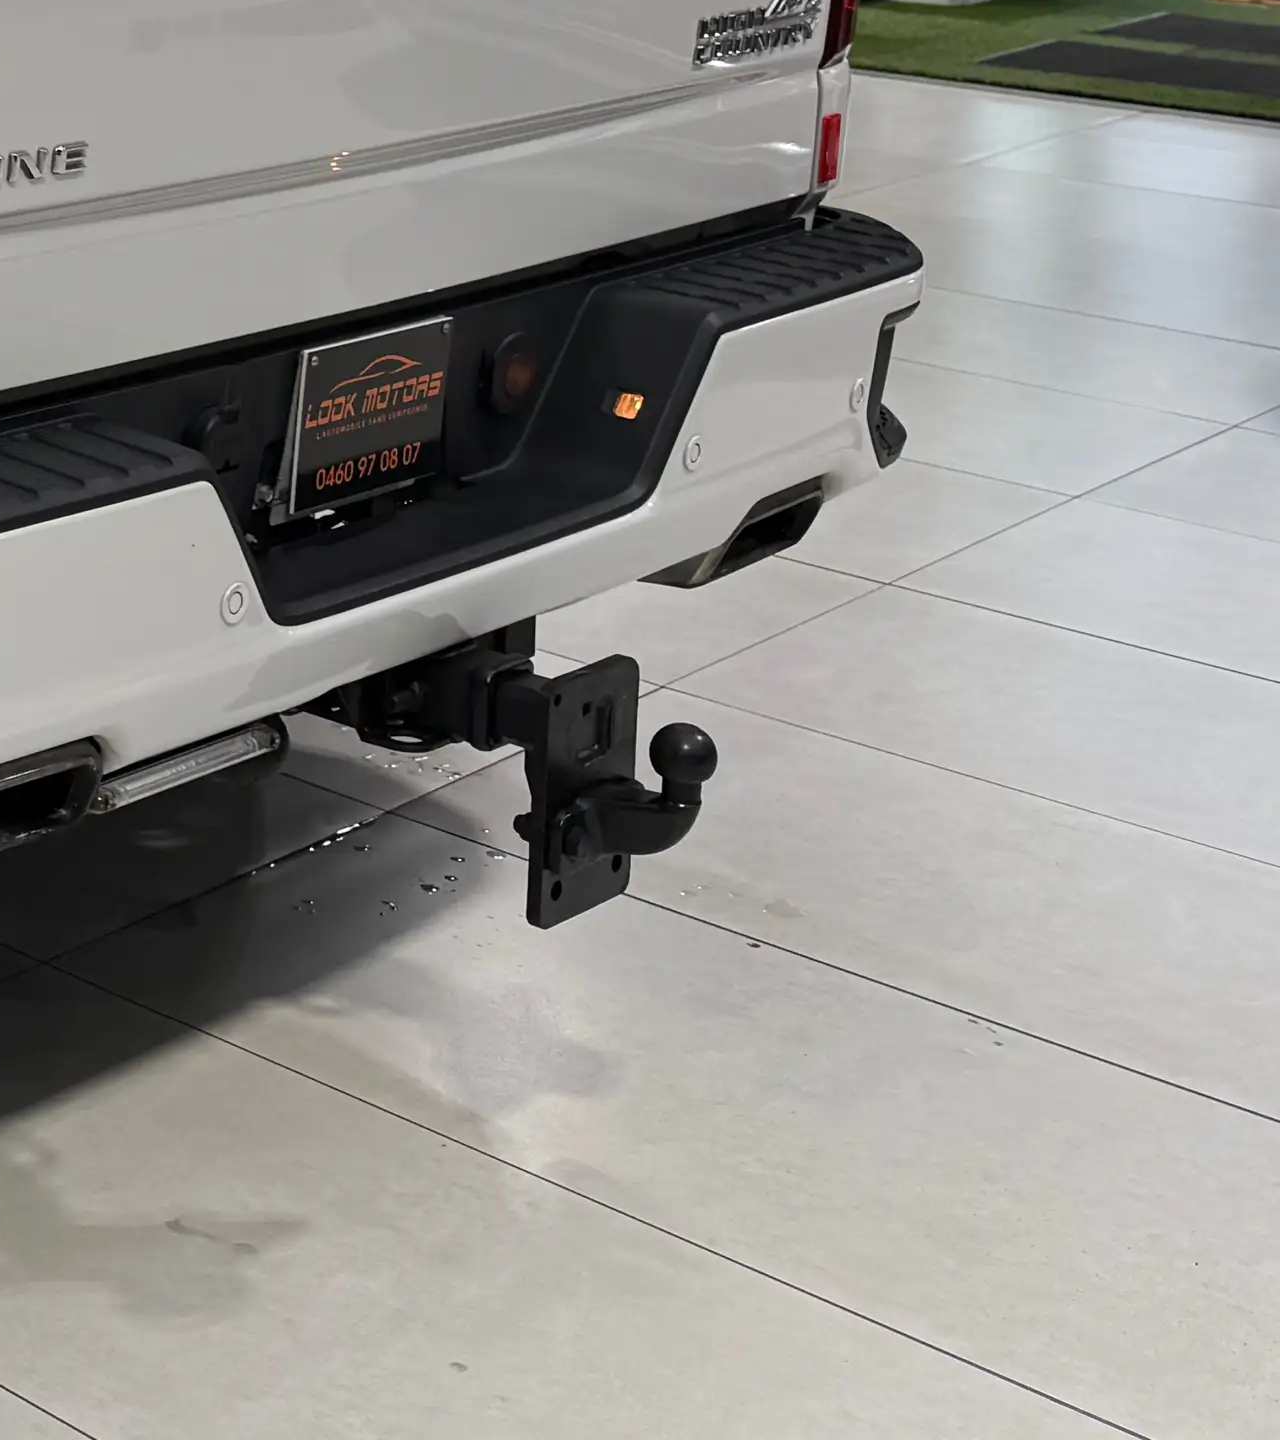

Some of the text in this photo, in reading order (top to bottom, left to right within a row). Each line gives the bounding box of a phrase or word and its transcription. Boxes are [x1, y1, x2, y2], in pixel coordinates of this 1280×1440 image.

[305, 371, 444, 429] LOOK MOTORS
[315, 441, 421, 491] 0460 97 08 07
